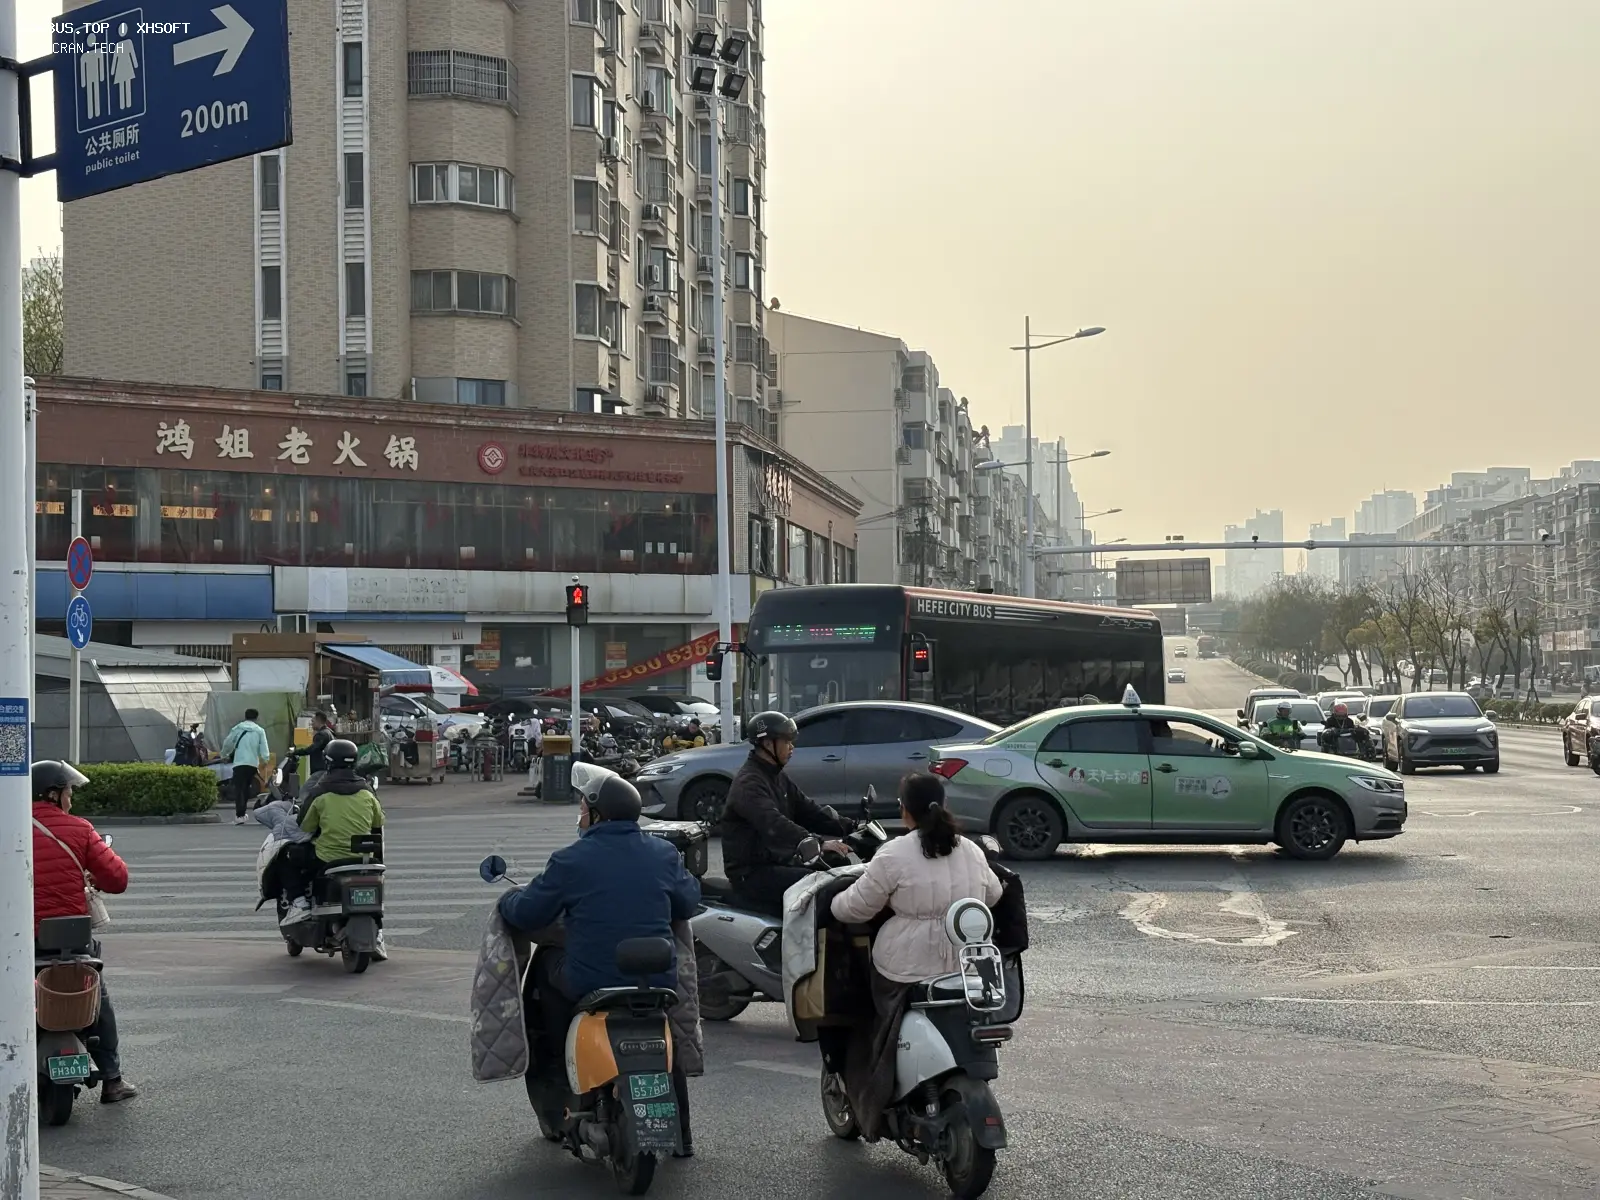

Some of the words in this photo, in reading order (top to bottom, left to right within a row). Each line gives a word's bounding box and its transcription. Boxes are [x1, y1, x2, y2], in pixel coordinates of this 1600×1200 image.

[180, 100, 249, 138] 200m
[85, 123, 140, 157] 公共厕所
[85, 157, 114, 176] public
[114, 150, 140, 167] toilet
[155, 418, 420, 471] 鸿姐老火锅
[917, 599, 948, 616] HEFEI
[949, 601, 972, 617] CITY
[973, 604, 992, 619] BUS
[52, 1066, 87, 1077] FH3016
